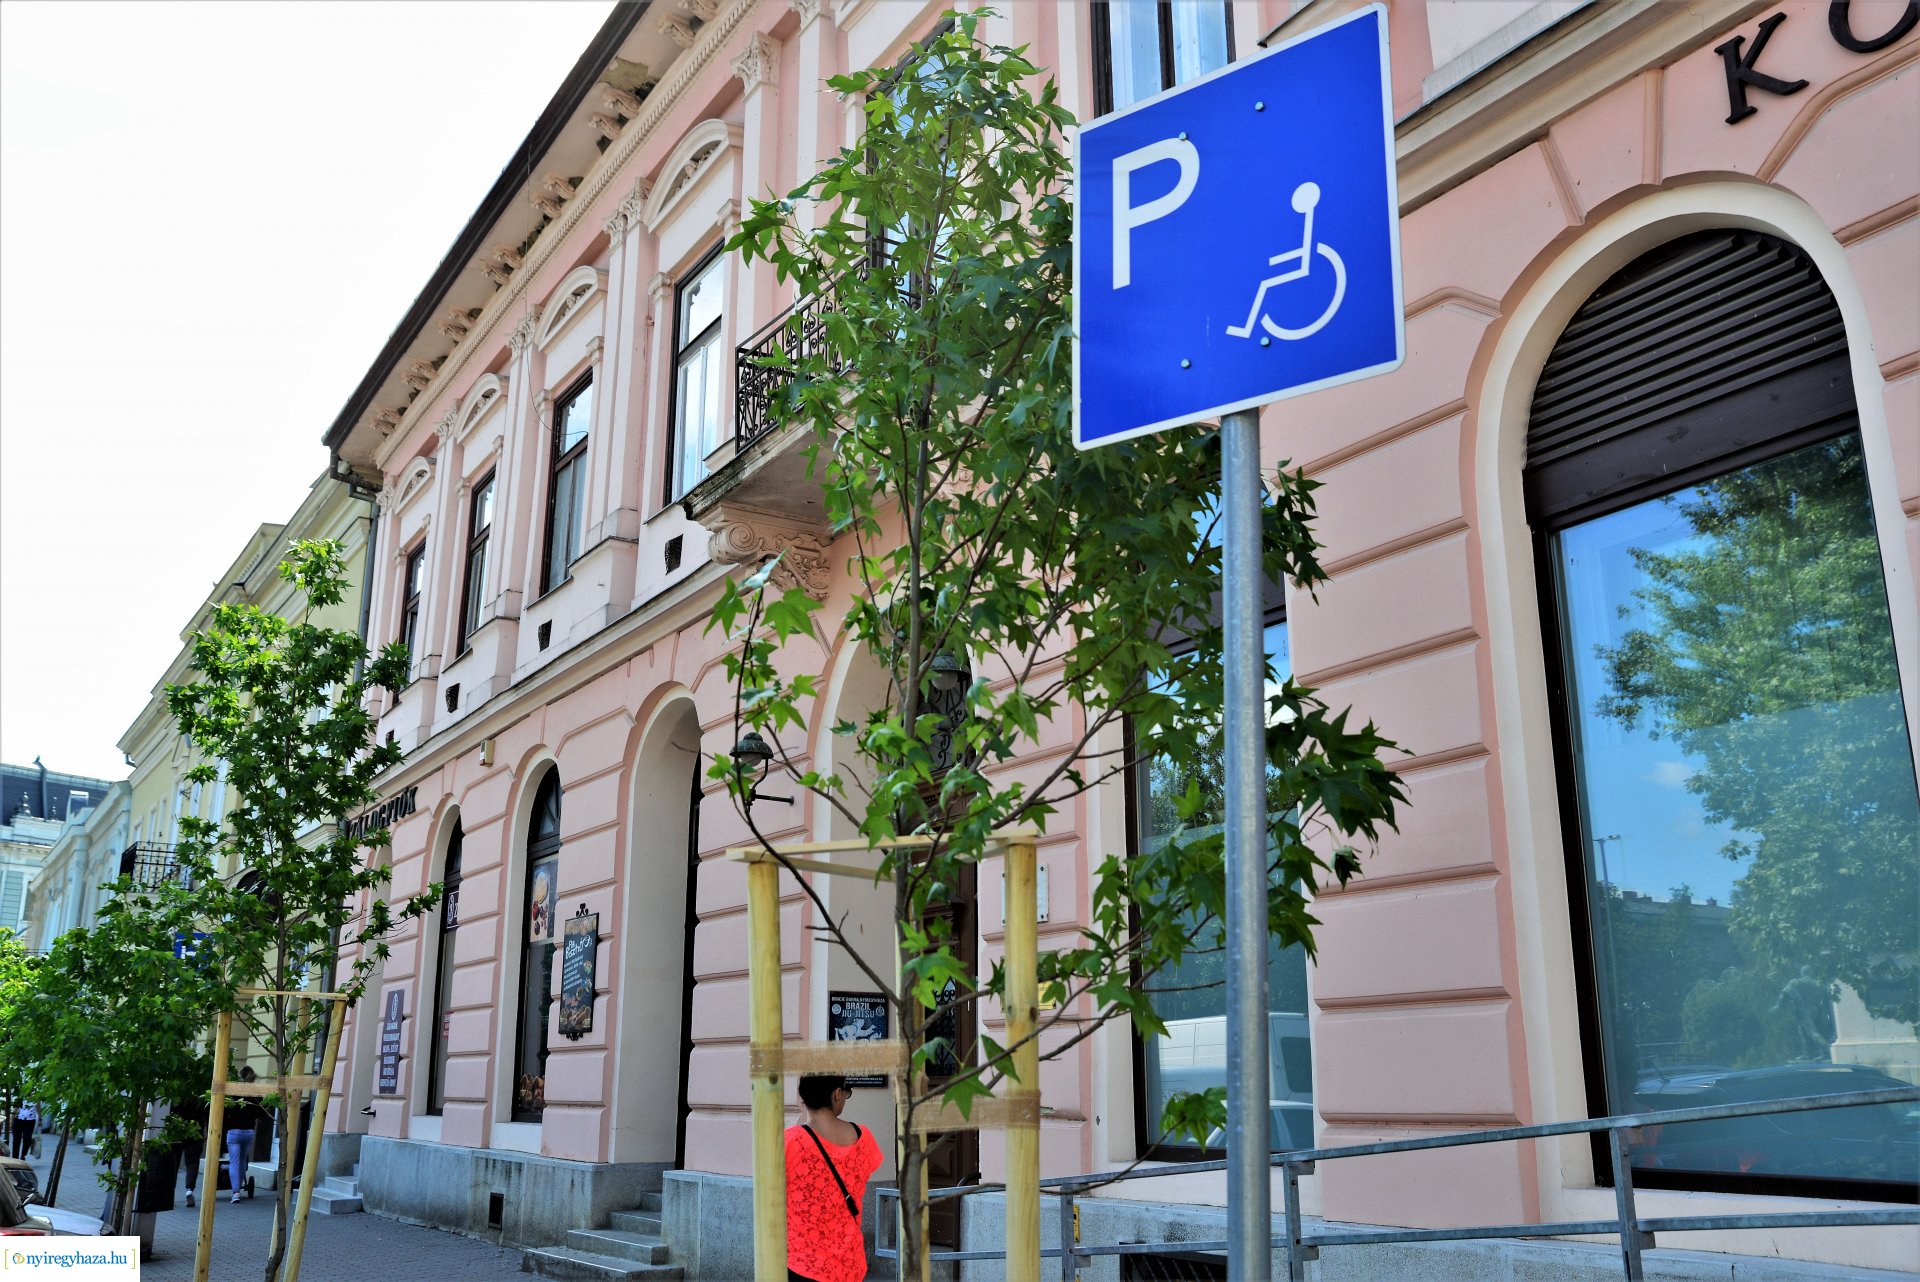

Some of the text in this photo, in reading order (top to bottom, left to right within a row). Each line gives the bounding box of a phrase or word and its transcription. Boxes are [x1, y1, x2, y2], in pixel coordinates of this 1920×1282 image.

[1112, 137, 1200, 290] P
[845, 1002, 870, 1010] BRAZIL
[841, 1010, 875, 1018] JIU-JITSU
